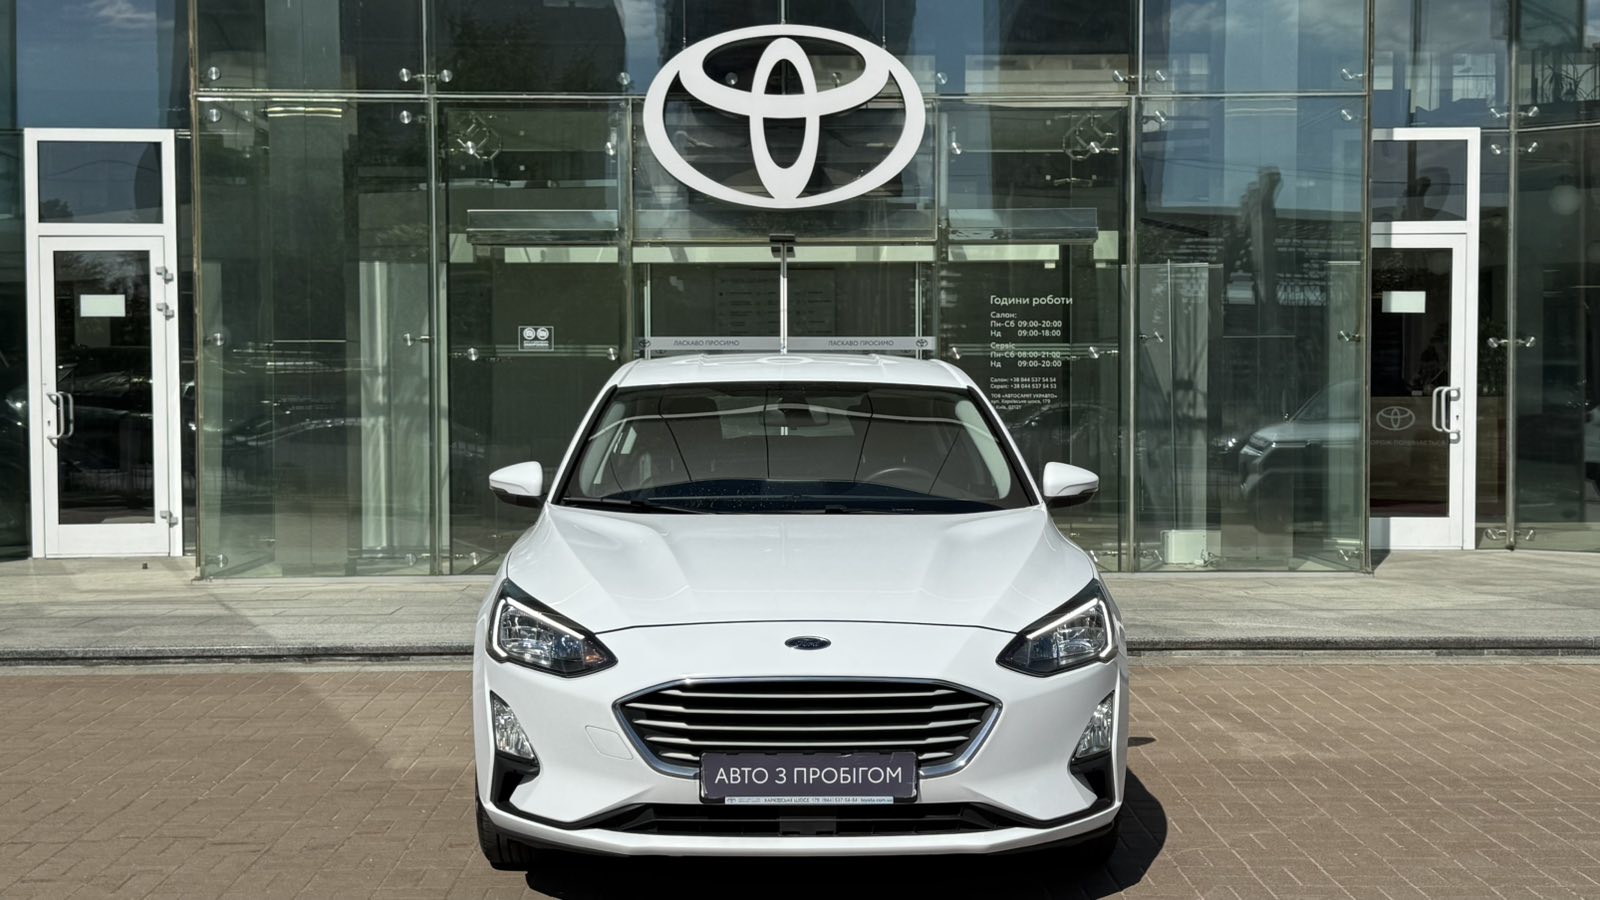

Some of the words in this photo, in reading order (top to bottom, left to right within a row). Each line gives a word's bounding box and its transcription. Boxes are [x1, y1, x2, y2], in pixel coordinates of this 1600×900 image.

[990, 295, 1030, 306] Години
[1032, 294, 1073, 307] роботи
[990, 311, 1017, 319] Салон:
[714, 767, 769, 784] АВТО
[793, 766, 902, 784] ПРОБІГОМ
